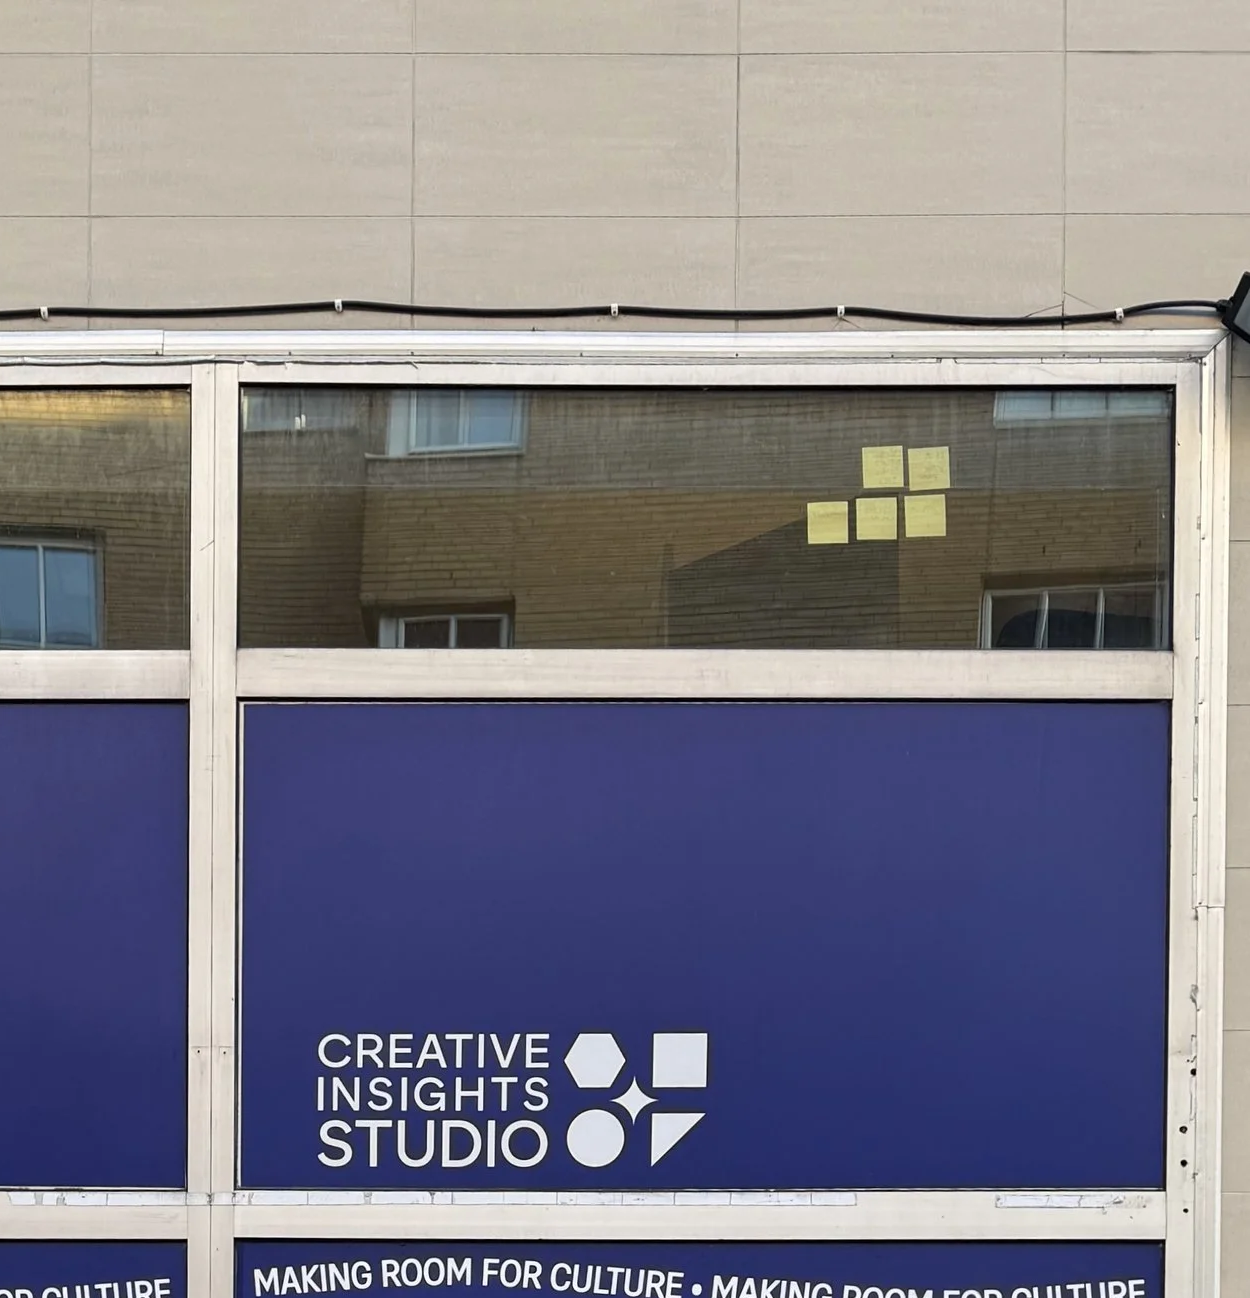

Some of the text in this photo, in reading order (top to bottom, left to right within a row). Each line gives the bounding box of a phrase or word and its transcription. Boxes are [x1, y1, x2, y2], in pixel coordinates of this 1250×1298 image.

[317, 1033, 550, 1068] CREATIVE
[317, 1076, 549, 1112] INSIGHTS
[317, 1119, 549, 1168] STUDIO
[253, 1260, 373, 1297] MAKING
[381, 1257, 472, 1288] ROOM
[482, 1258, 543, 1290] FOR
